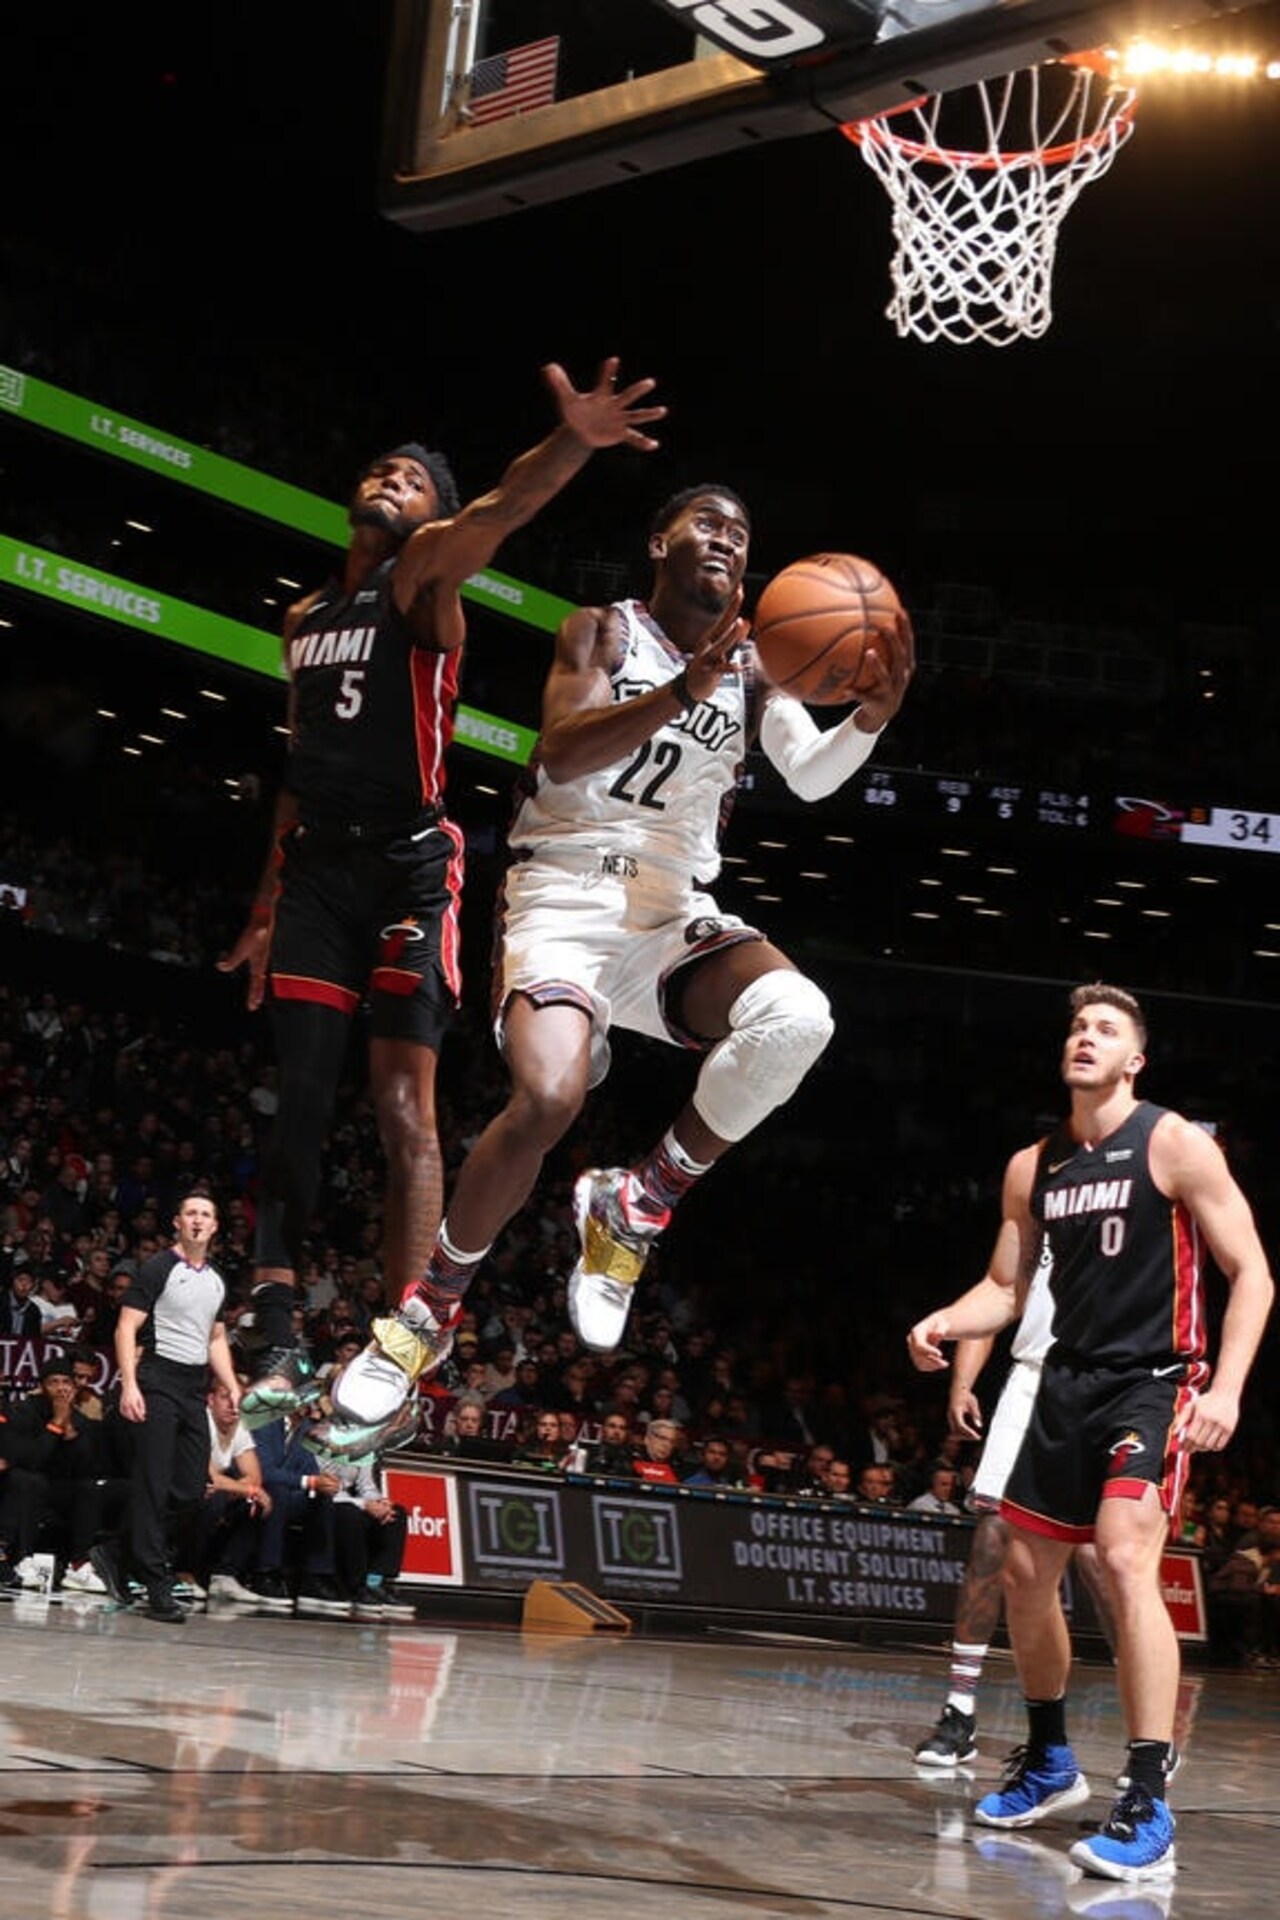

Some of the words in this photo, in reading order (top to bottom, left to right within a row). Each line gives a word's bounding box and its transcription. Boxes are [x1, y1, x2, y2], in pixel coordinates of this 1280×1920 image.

[117, 426, 192, 469] SERVICES
[16, 552, 50, 585] I.T.
[57, 567, 161, 624] SERVICES
[335, 670, 365, 719] 5
[609, 740, 682, 811] 22
[947, 797, 961, 813] 9
[998, 803, 1012, 819] 5
[1076, 796, 1089, 808] 4
[1229, 813, 1272, 844] 34
[602, 855, 639, 878] NETS
[1044, 1179, 1132, 1220] MIAMI
[1101, 1216, 1125, 1256] 0
[479, 1497, 553, 1554] TGI
[602, 1510, 671, 1564] TGI
[751, 1511, 826, 1543] OFFICE
[831, 1520, 946, 1552] EQUIPMENT
[733, 1541, 850, 1576] DOCUMENT
[857, 1552, 965, 1584] SOLUTIONS
[787, 1576, 826, 1604] I.T.
[829, 1581, 926, 1611] SERVICES
